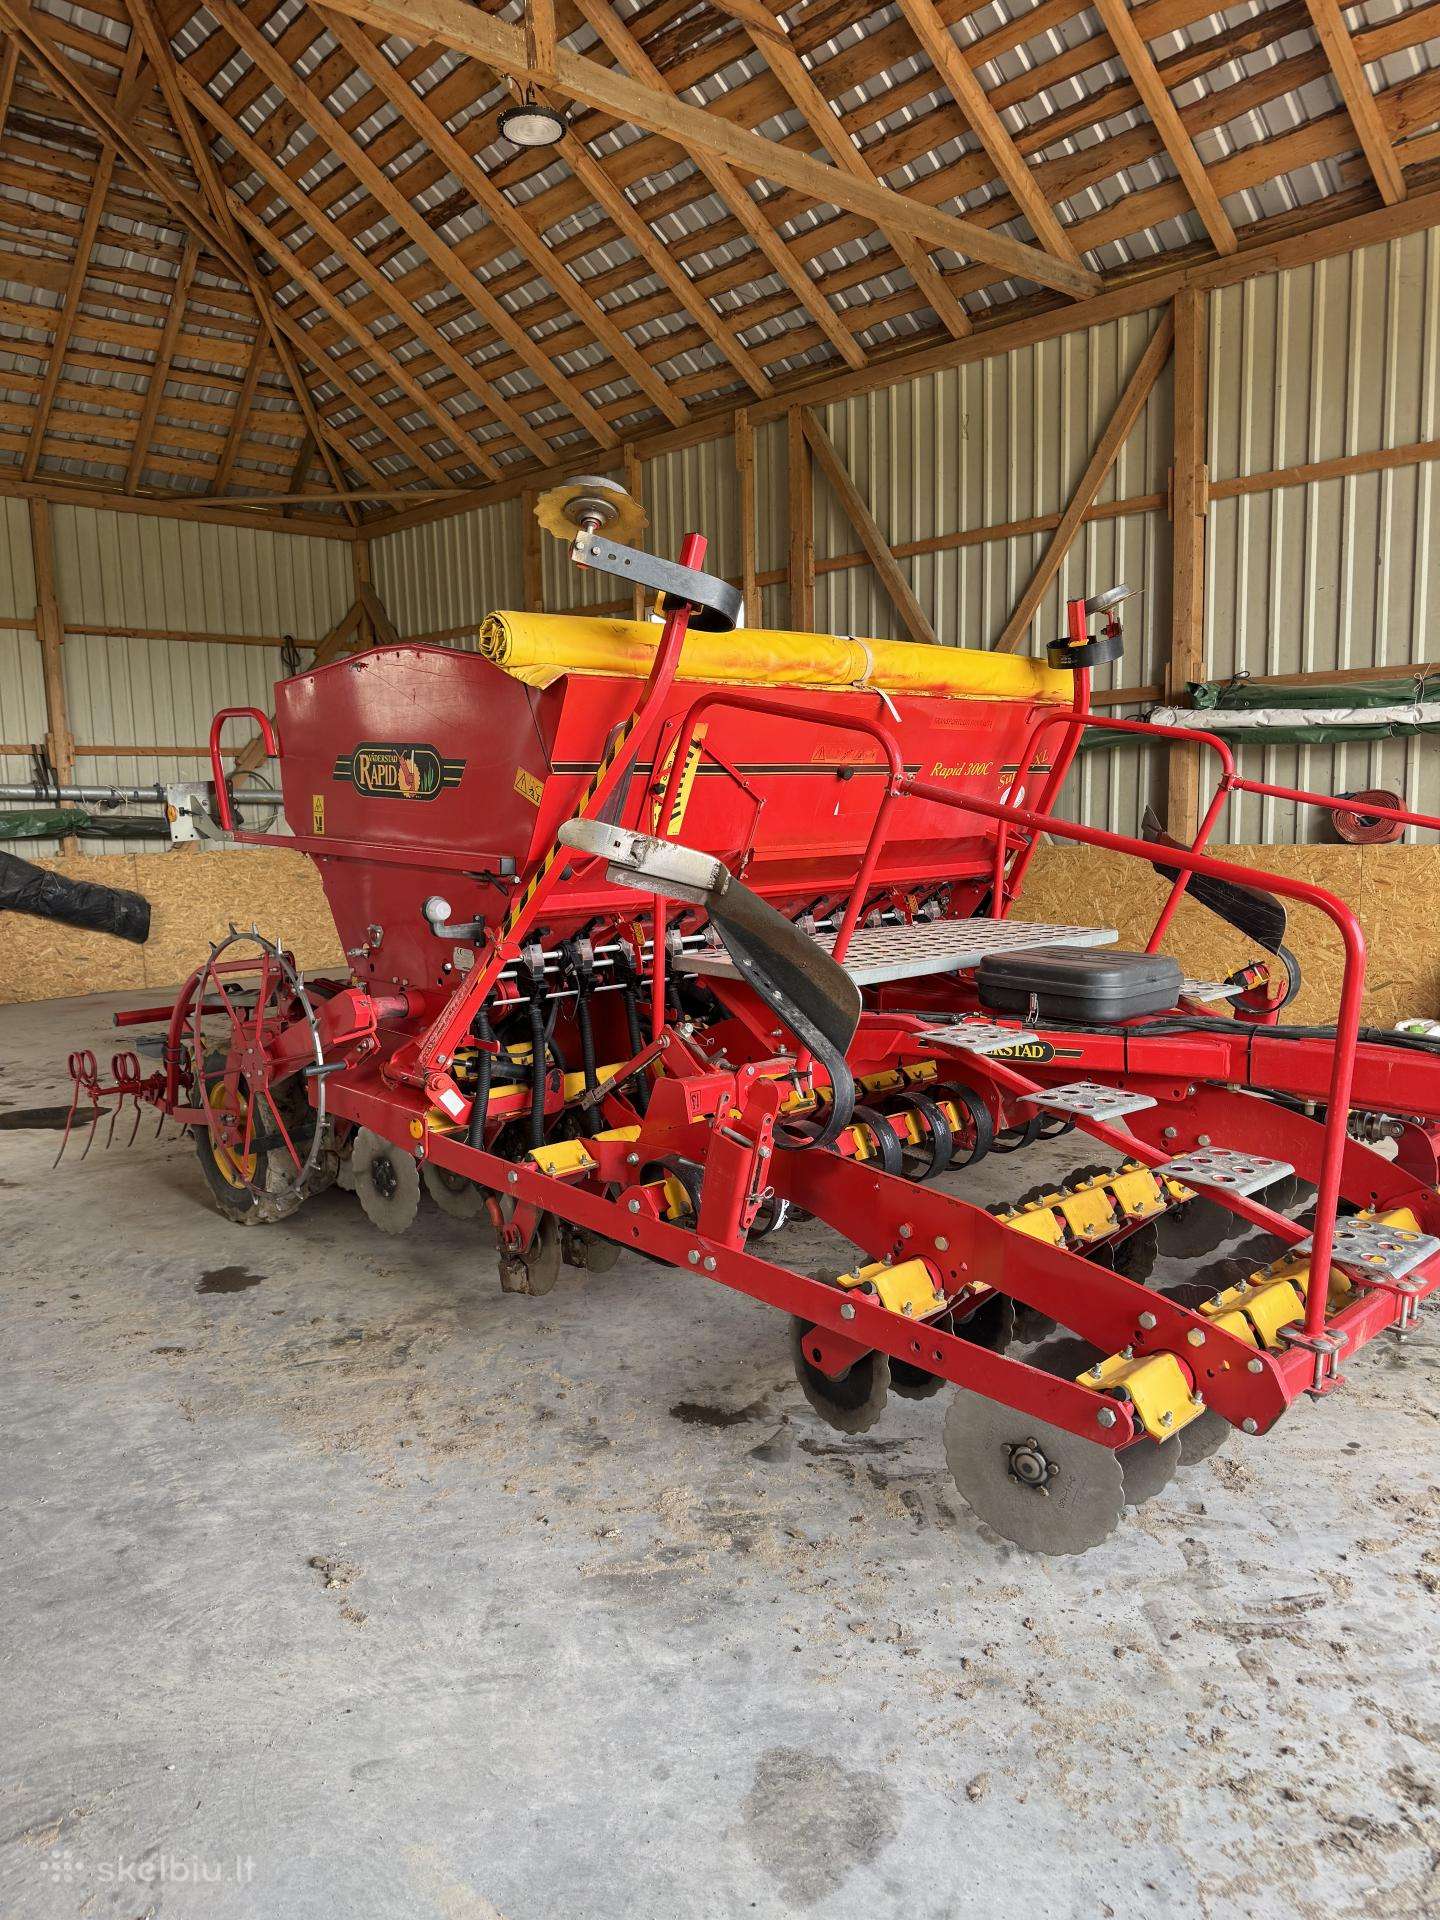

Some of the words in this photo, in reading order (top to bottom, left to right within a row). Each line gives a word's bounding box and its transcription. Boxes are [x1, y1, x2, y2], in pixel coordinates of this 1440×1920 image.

[359, 754, 398, 790] RAPID
[930, 761, 966, 779] Rapid
[964, 761, 994, 776] 300C
[983, 1044, 1044, 1058] RSTAD
